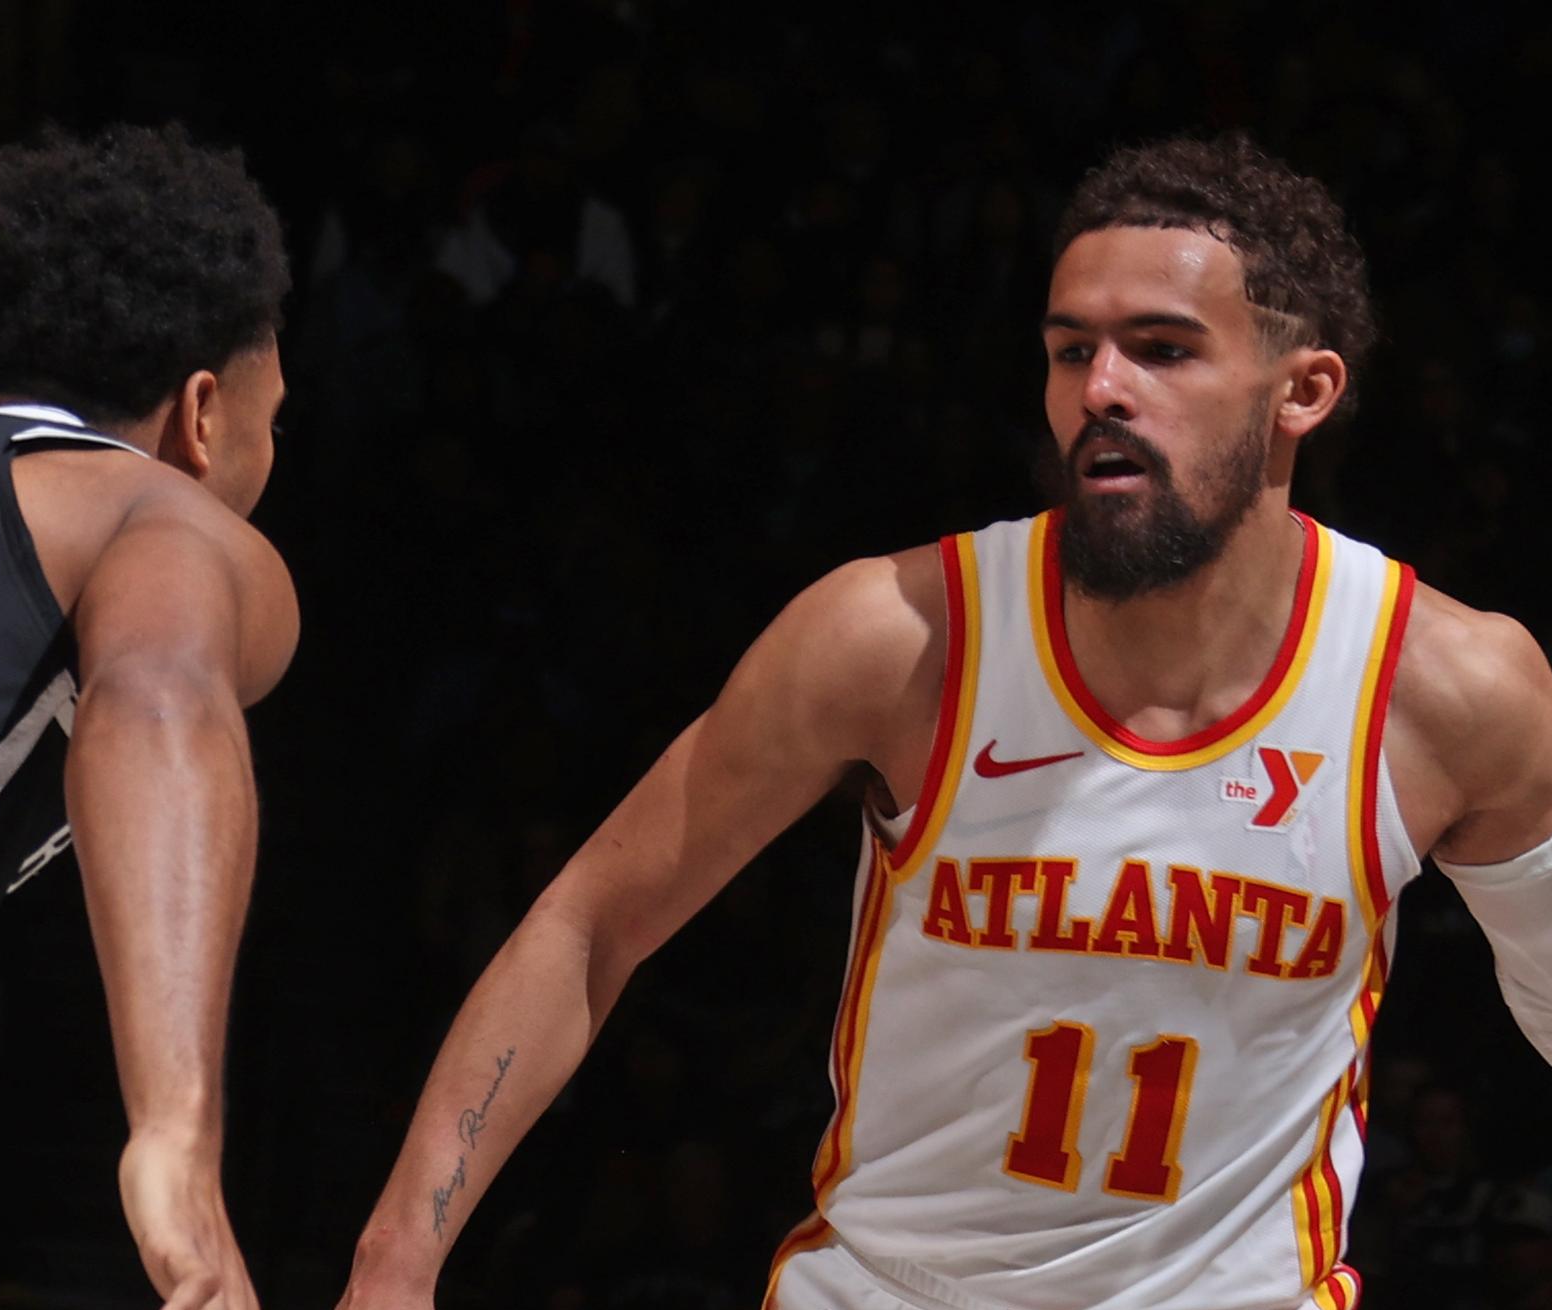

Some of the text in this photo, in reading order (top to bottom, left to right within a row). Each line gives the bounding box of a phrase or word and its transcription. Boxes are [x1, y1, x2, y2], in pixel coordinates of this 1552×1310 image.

[1225, 781, 1257, 800] the
[921, 856, 1347, 980] ATLANTA
[1002, 1018, 1201, 1204] 11
